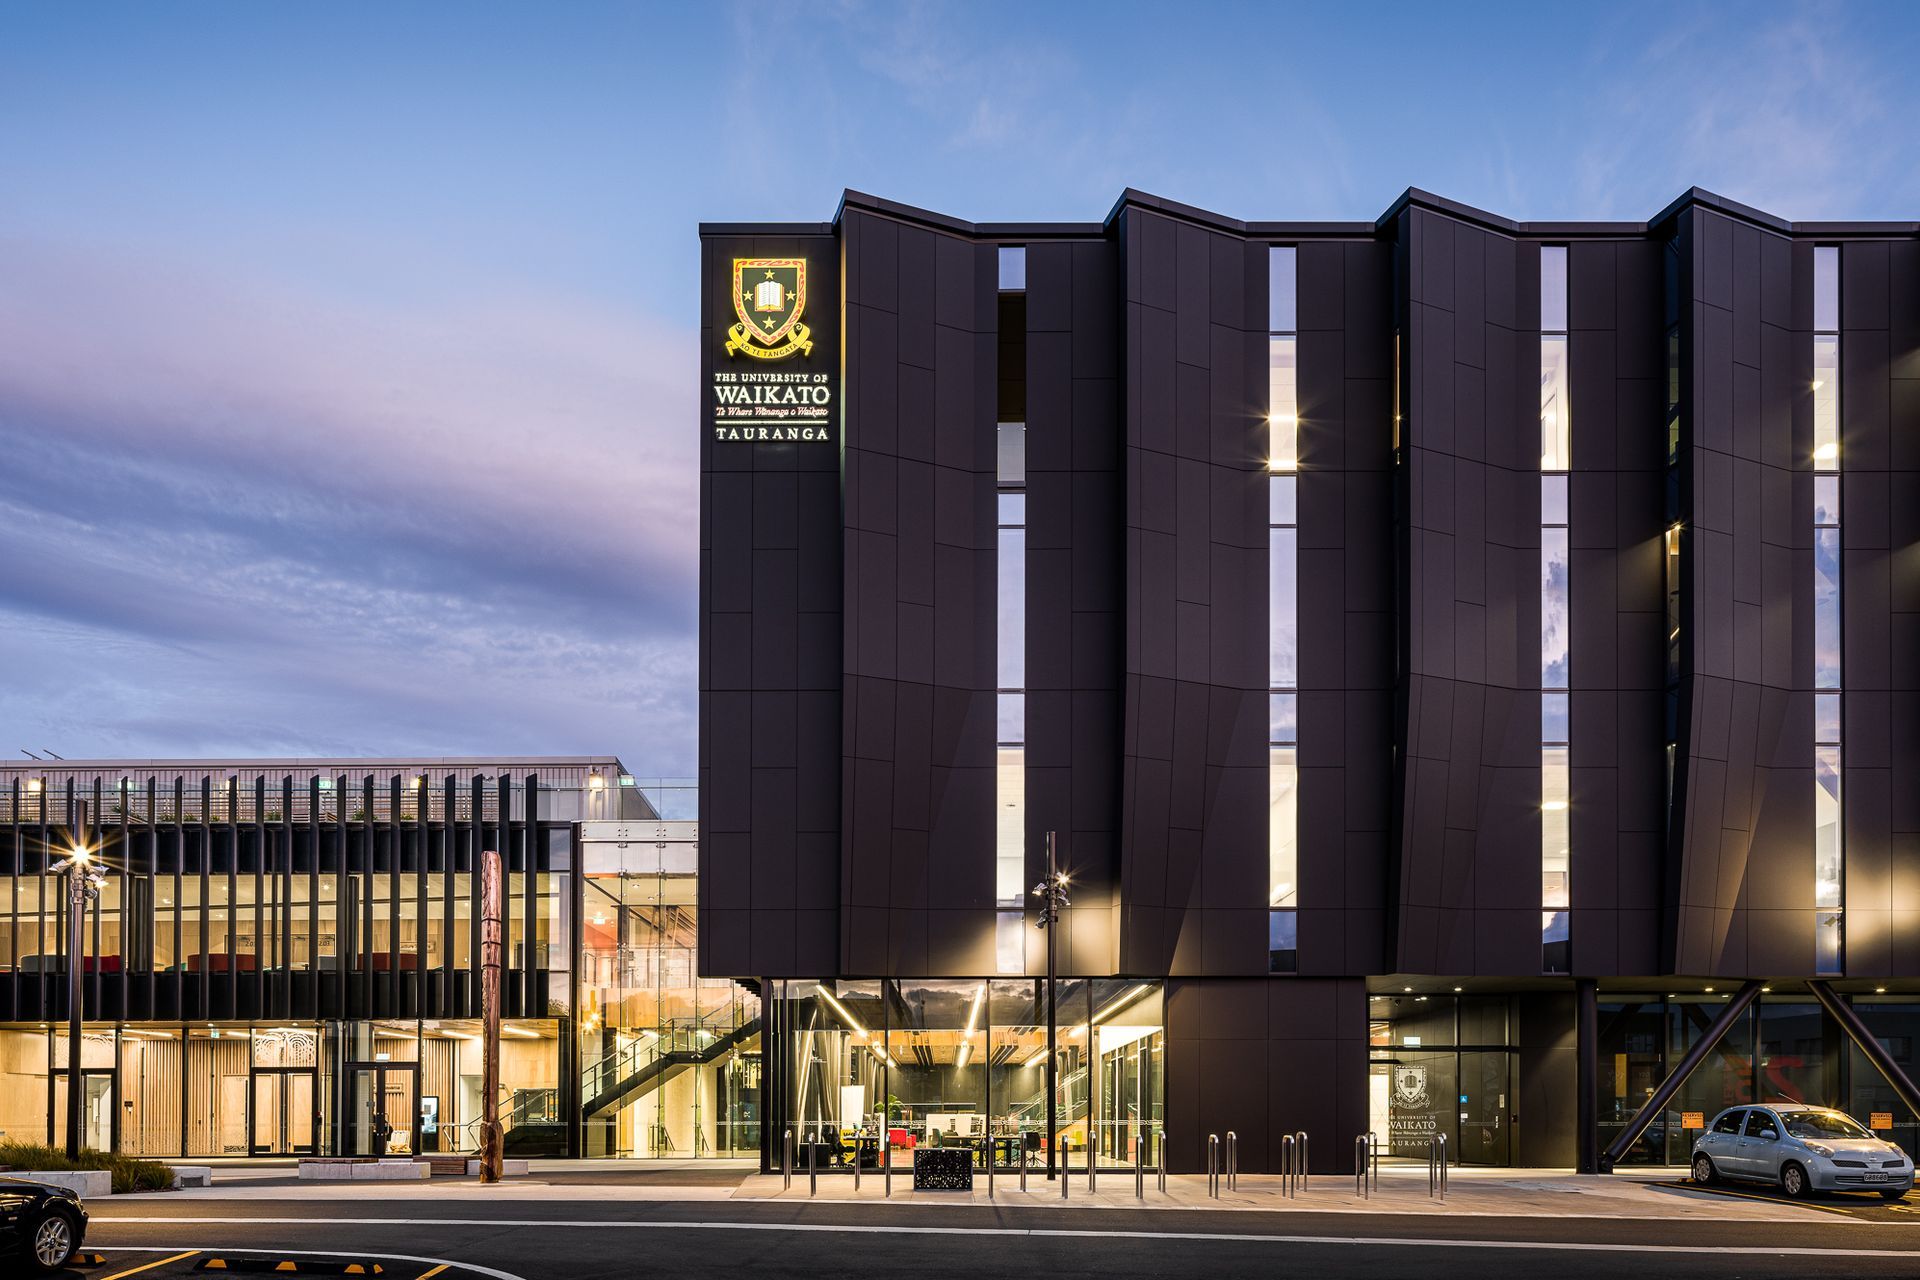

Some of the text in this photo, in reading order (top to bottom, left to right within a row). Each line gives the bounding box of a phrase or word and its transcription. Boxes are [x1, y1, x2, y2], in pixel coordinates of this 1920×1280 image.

[741, 342, 798, 357] KO TE TANGATA
[714, 373, 828, 383] THE UNIVERSITY OF
[714, 385, 831, 405] WAIKATO
[715, 406, 726, 416] Te
[727, 406, 753, 416] Whare
[790, 408, 796, 416] o
[797, 406, 829, 418] Waikato
[716, 427, 828, 440] TAURANGA
